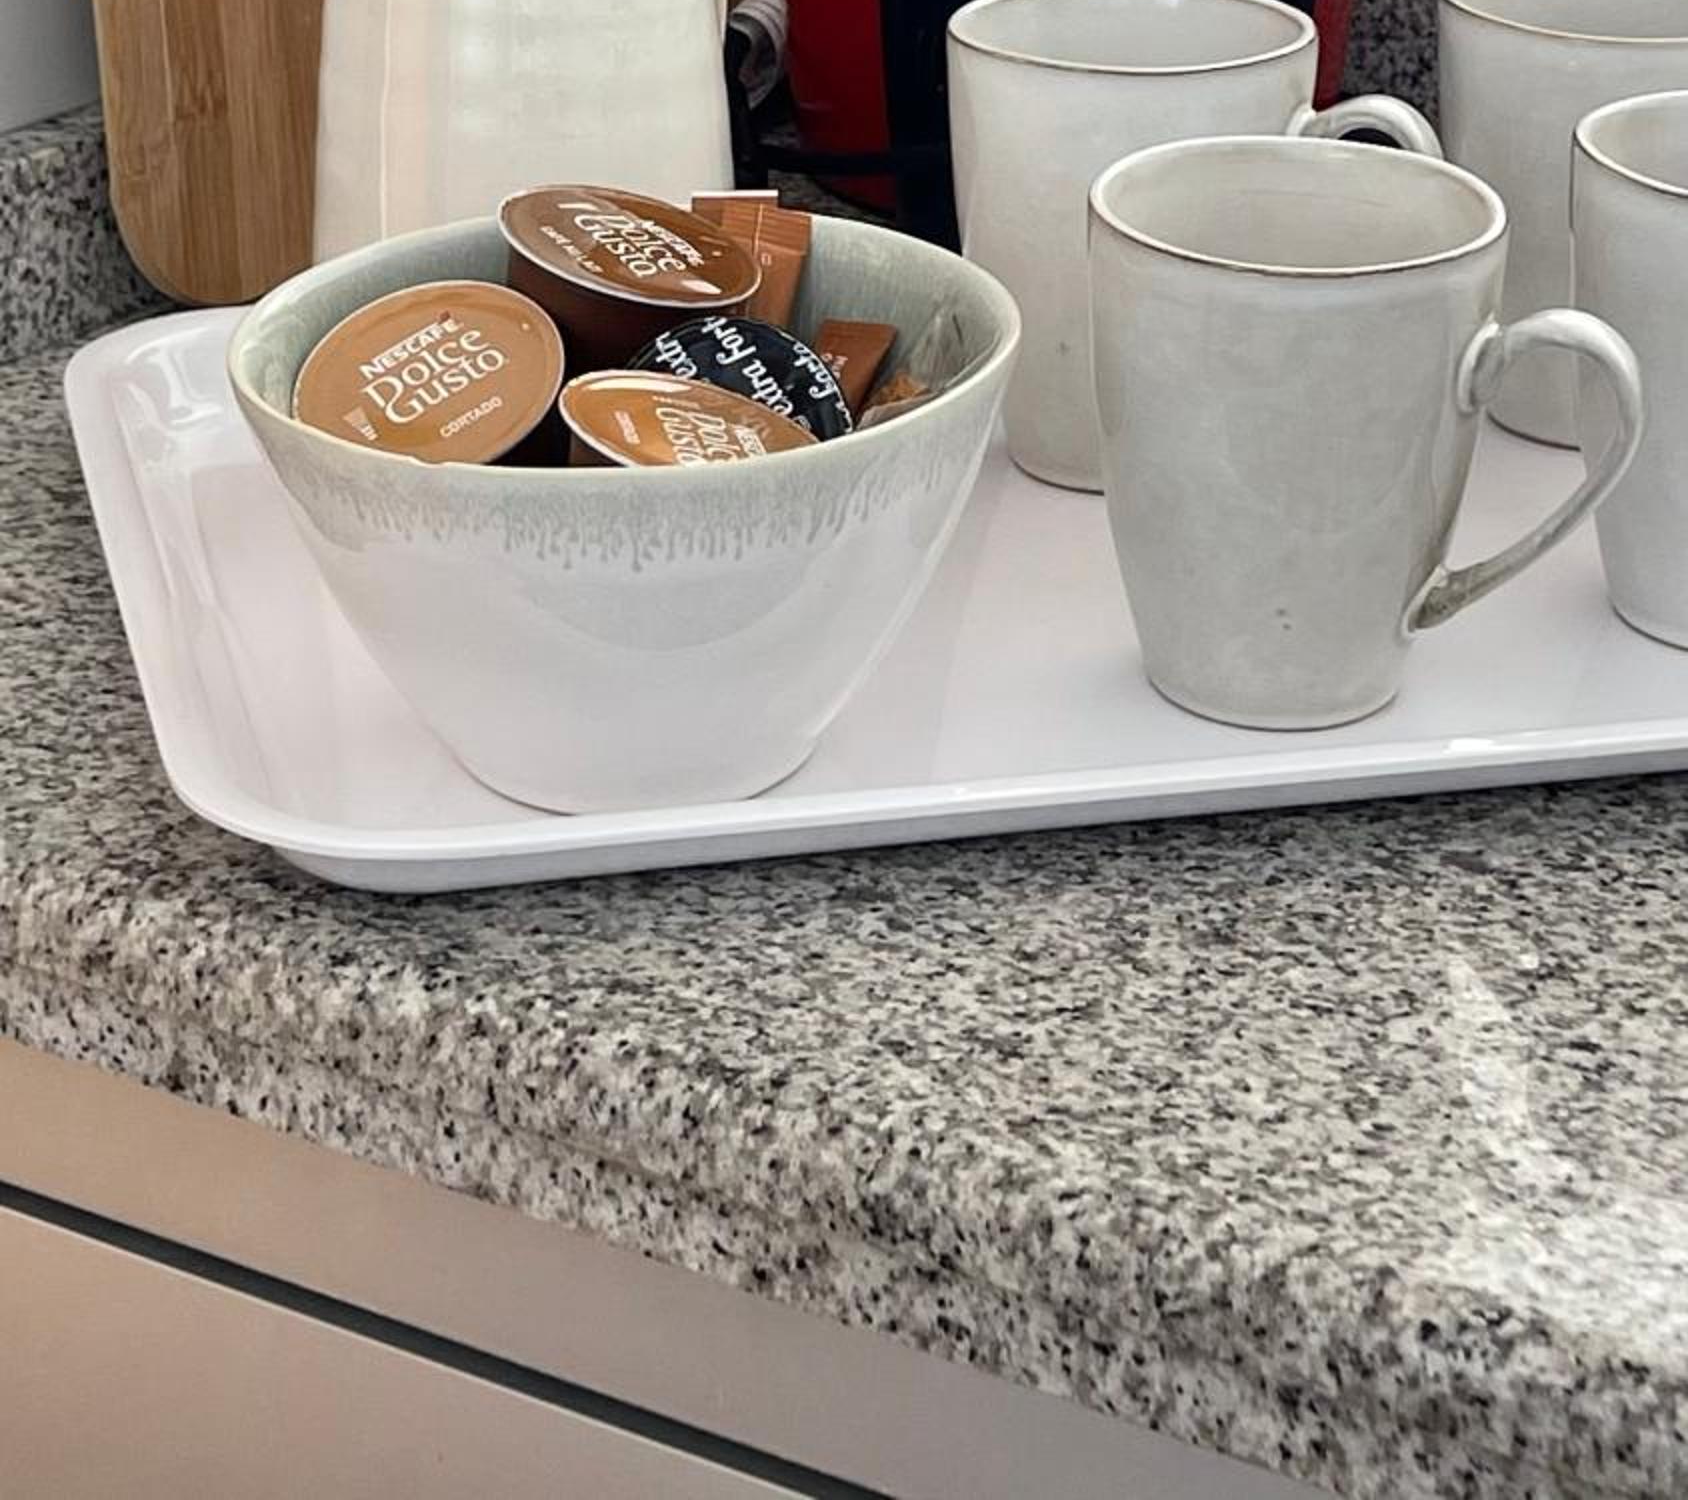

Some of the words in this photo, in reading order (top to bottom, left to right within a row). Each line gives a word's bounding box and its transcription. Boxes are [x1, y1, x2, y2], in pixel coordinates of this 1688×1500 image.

[574, 214, 658, 277] Gusto
[600, 214, 687, 272] Dolce
[361, 330, 490, 409] Dolce
[655, 331, 699, 380] extr
[384, 349, 505, 424] Gusto
[743, 359, 794, 417] extra
[440, 396, 503, 438] CORTADO
[687, 411, 740, 462] Dolc
